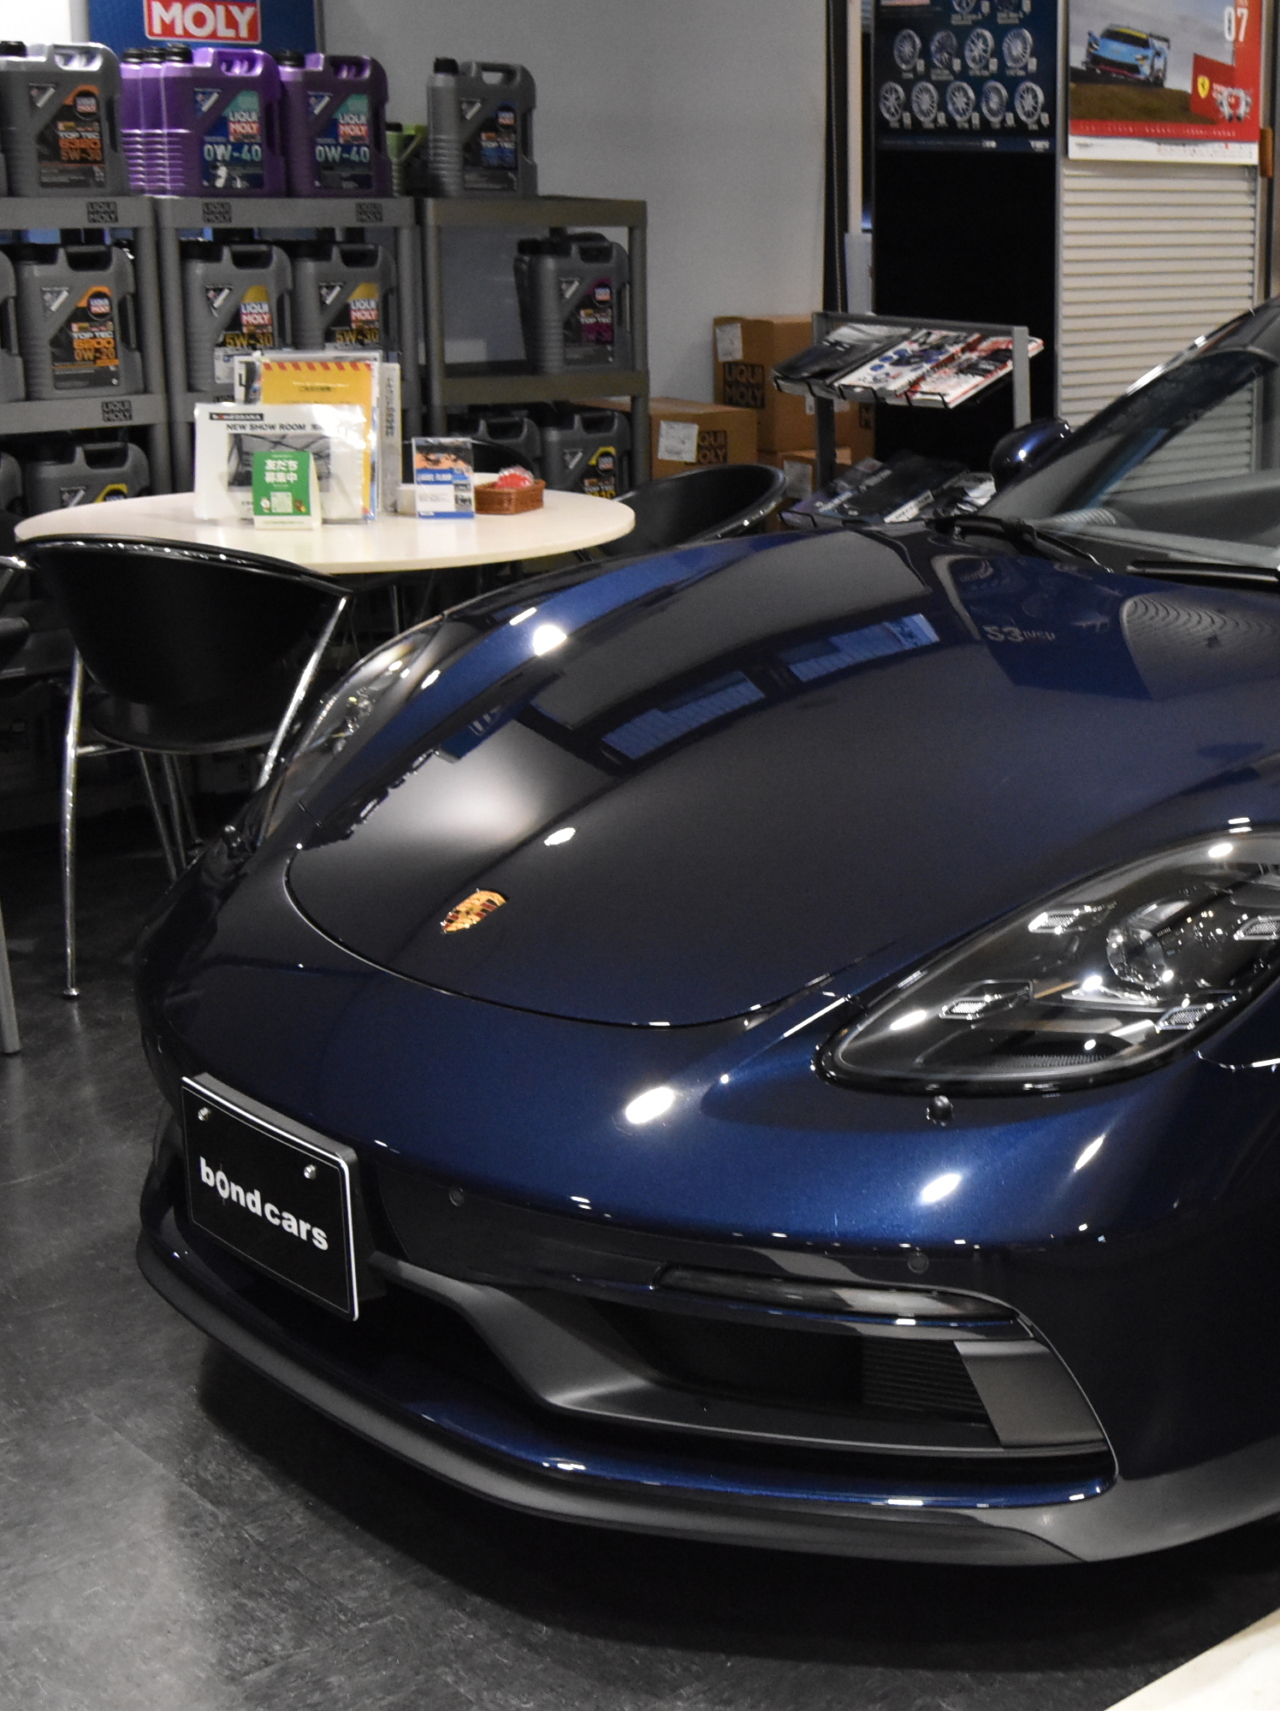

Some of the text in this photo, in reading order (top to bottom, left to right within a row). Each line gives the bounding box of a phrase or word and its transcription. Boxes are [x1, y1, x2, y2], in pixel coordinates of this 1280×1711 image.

[151, 0, 256, 38] MOLY
[1224, 6, 1248, 42] 07
[229, 111, 259, 122] LIQUI
[339, 113, 367, 124] LIQUI
[229, 122, 260, 135] MOLY
[339, 124, 369, 135] MOLY
[204, 144, 262, 161] 0W-40
[315, 146, 370, 162] 0W-40
[241, 303, 269, 313] LIQUI
[351, 299, 376, 310] LIQUI
[242, 314, 271, 325] MOLY
[351, 310, 378, 321] MOLY
[72, 331, 94, 339] TOP
[225, 332, 274, 347] 5W-30
[336, 328, 379, 343] 5W-30
[725, 362, 763, 384] LIQUI
[725, 385, 764, 408] MOLY
[226, 423, 247, 431] NEW
[249, 423, 276, 431] SHOW
[279, 423, 306, 431] ROOM
[699, 448, 727, 463] OLY
[264, 459, 298, 471] 友だち
